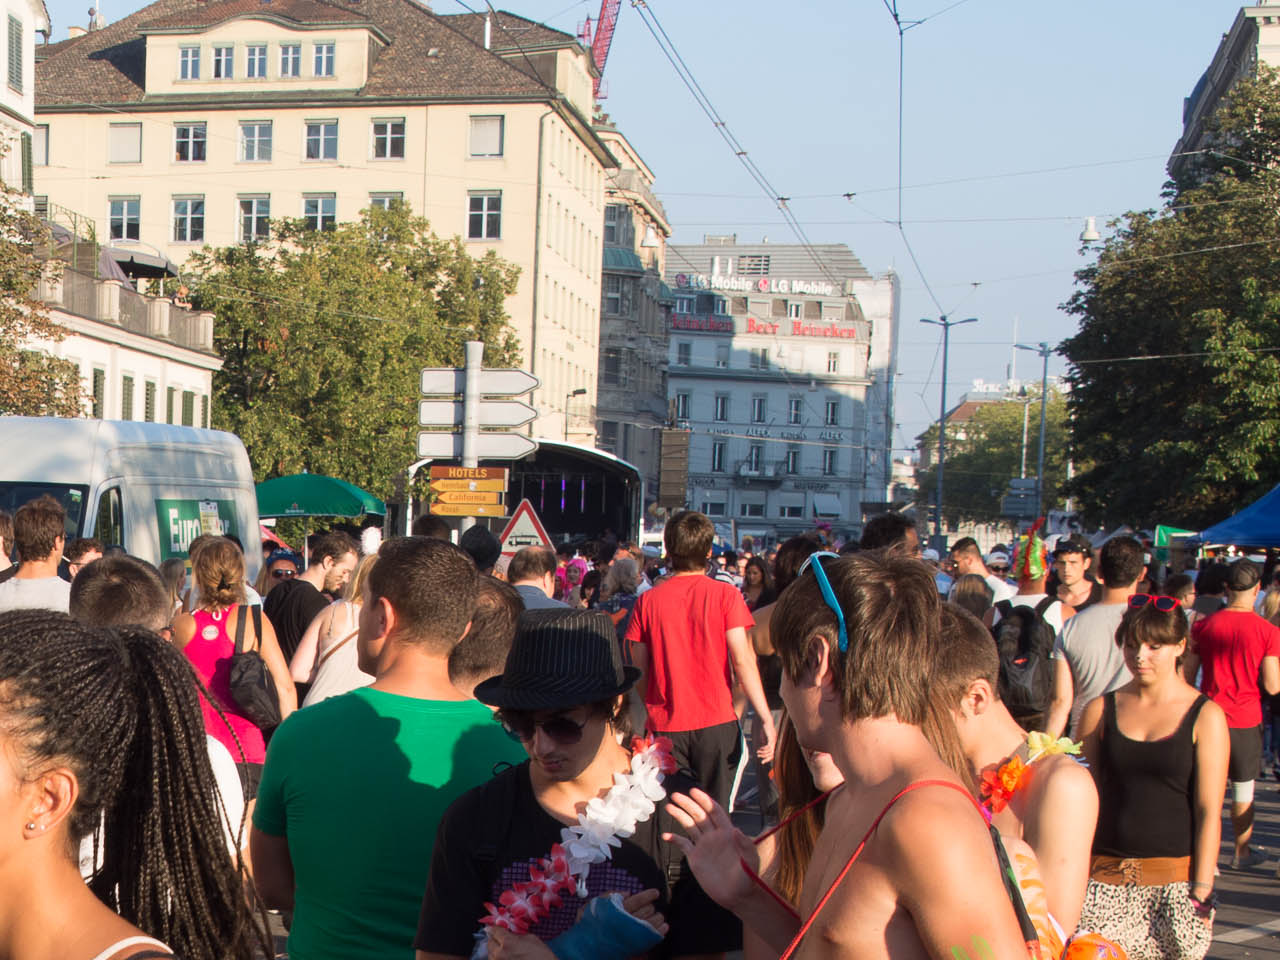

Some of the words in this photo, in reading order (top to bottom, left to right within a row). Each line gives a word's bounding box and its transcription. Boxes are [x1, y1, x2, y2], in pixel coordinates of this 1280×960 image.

[711, 274, 753, 291] Mobile
[771, 280, 788, 293] LG
[791, 280, 833, 295] Mobile
[747, 317, 779, 334] Beer
[792, 320, 856, 338] Heineken
[448, 467, 487, 478] HOTELS
